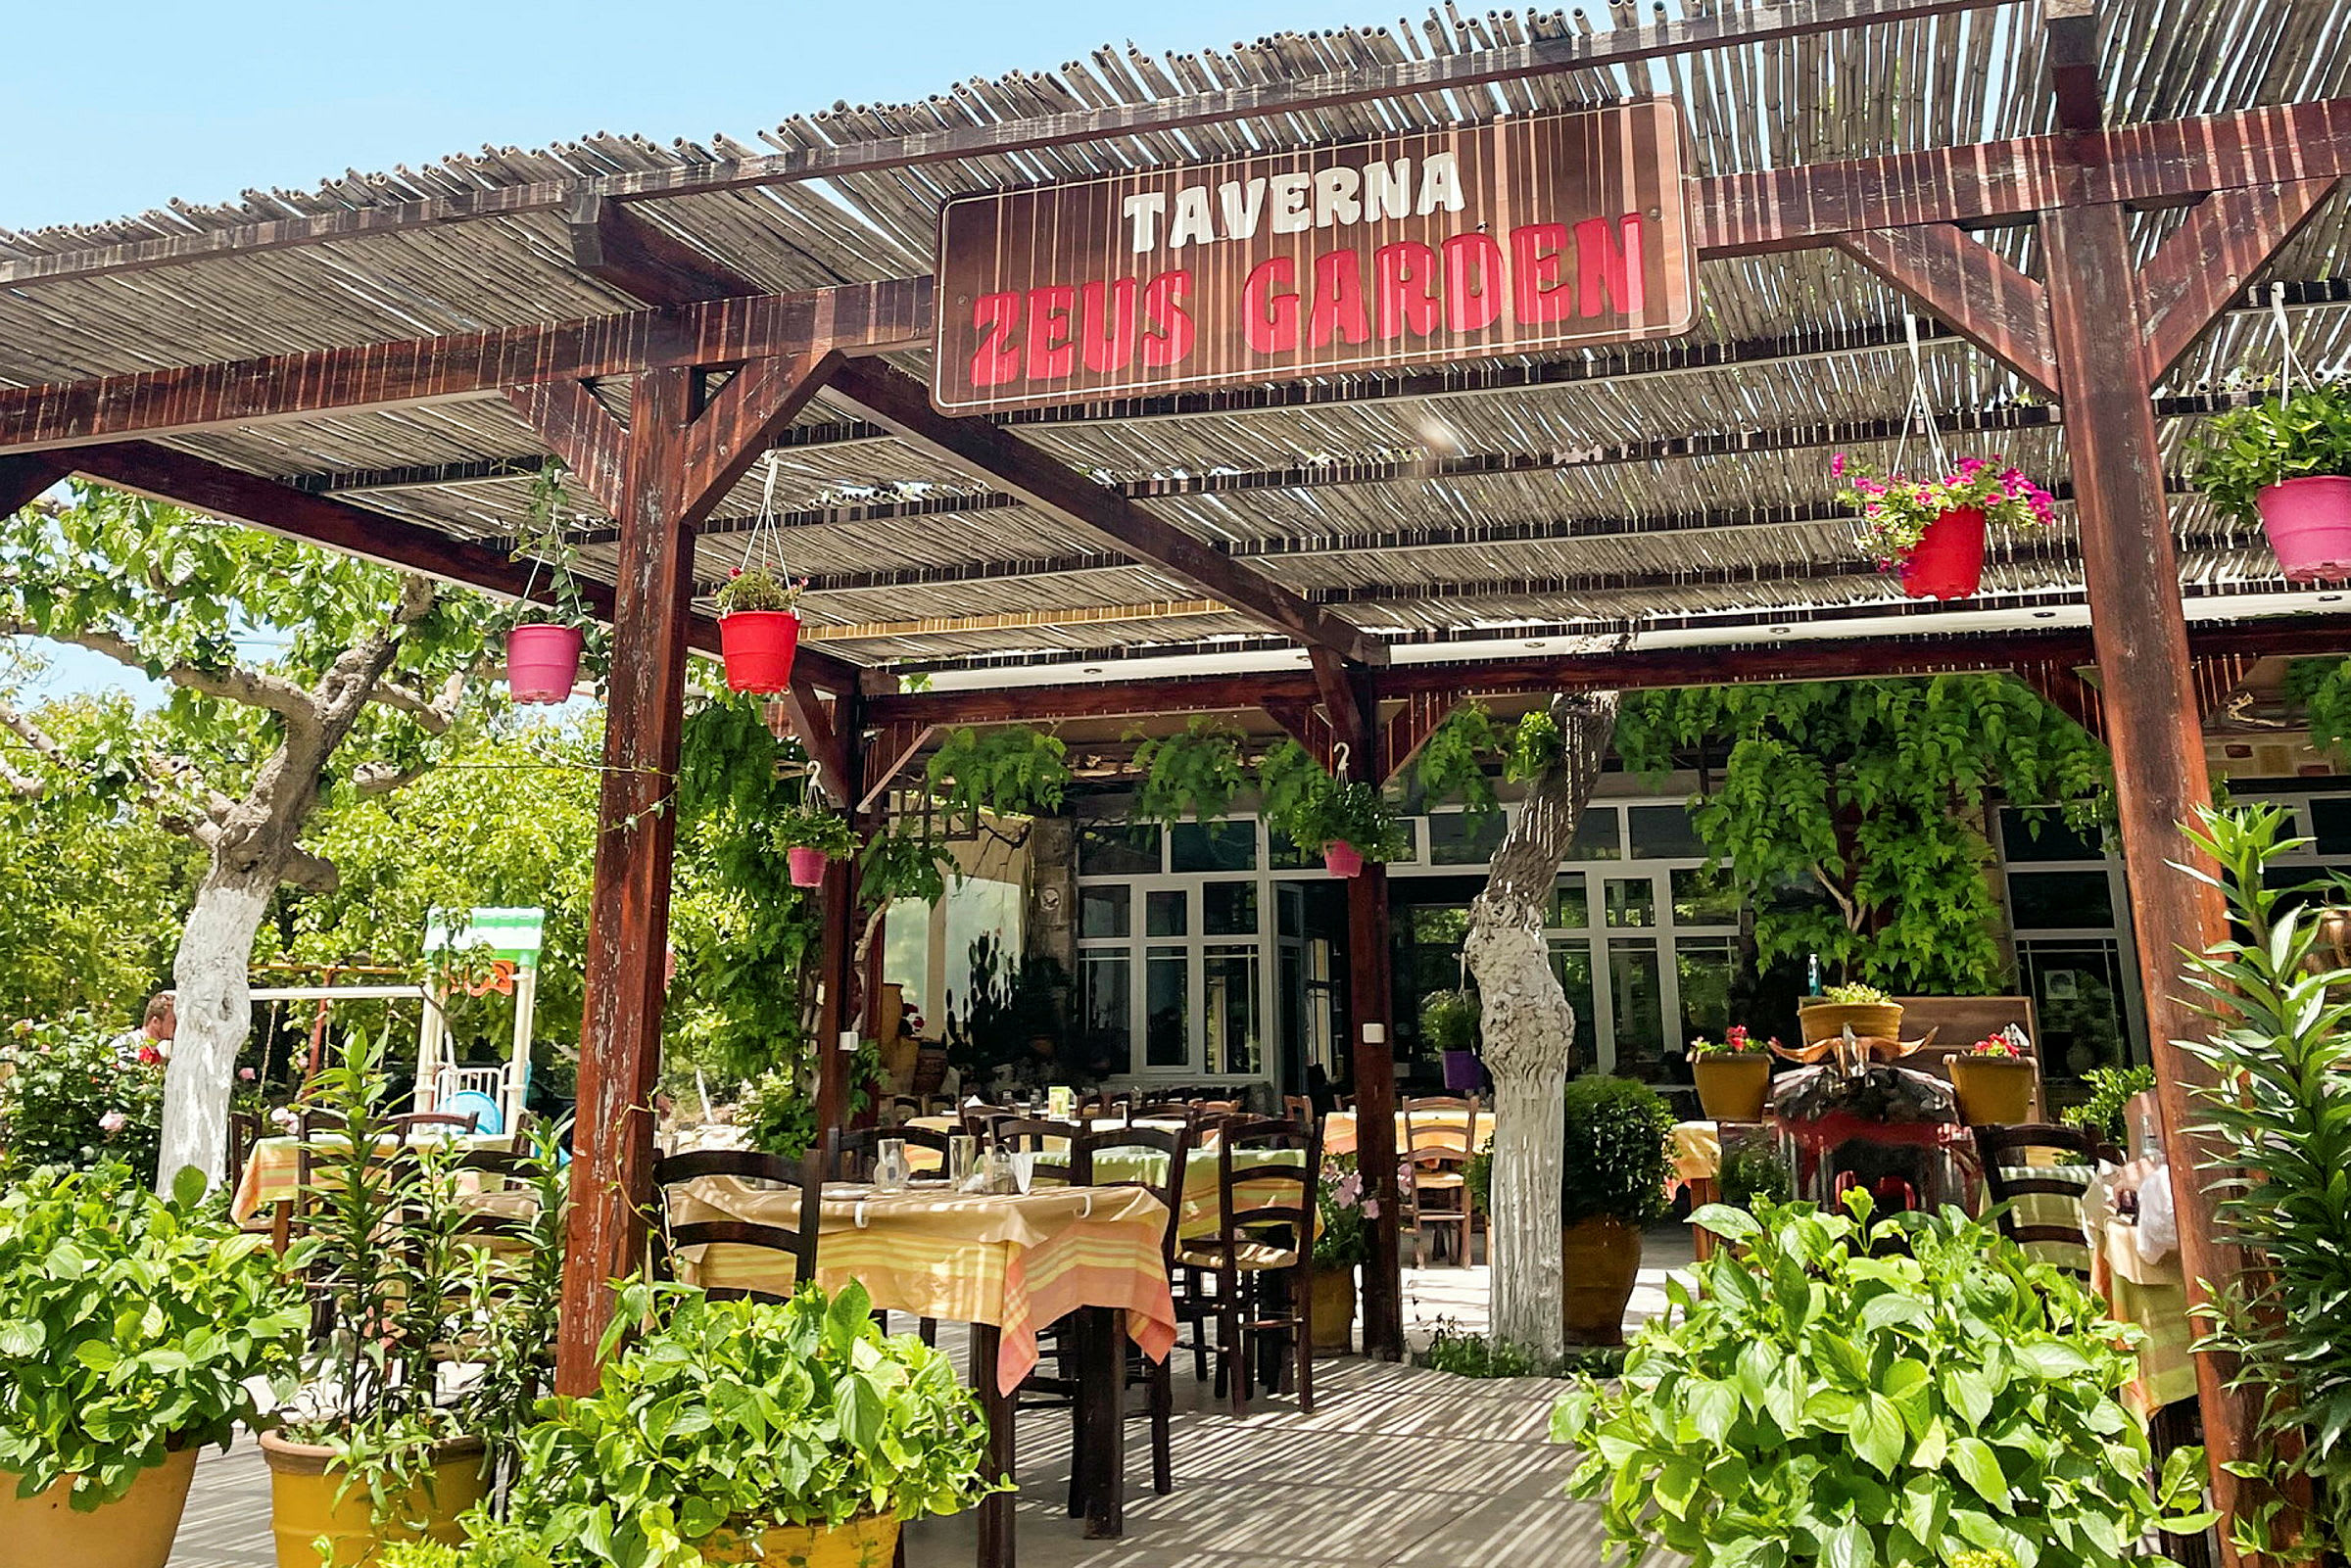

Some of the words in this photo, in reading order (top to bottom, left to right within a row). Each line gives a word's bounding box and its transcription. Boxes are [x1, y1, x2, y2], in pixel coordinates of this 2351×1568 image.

[1123, 151, 1465, 254] TAVERNA
[969, 268, 1196, 387] ZEUS
[1242, 212, 1646, 355] GARDEN
